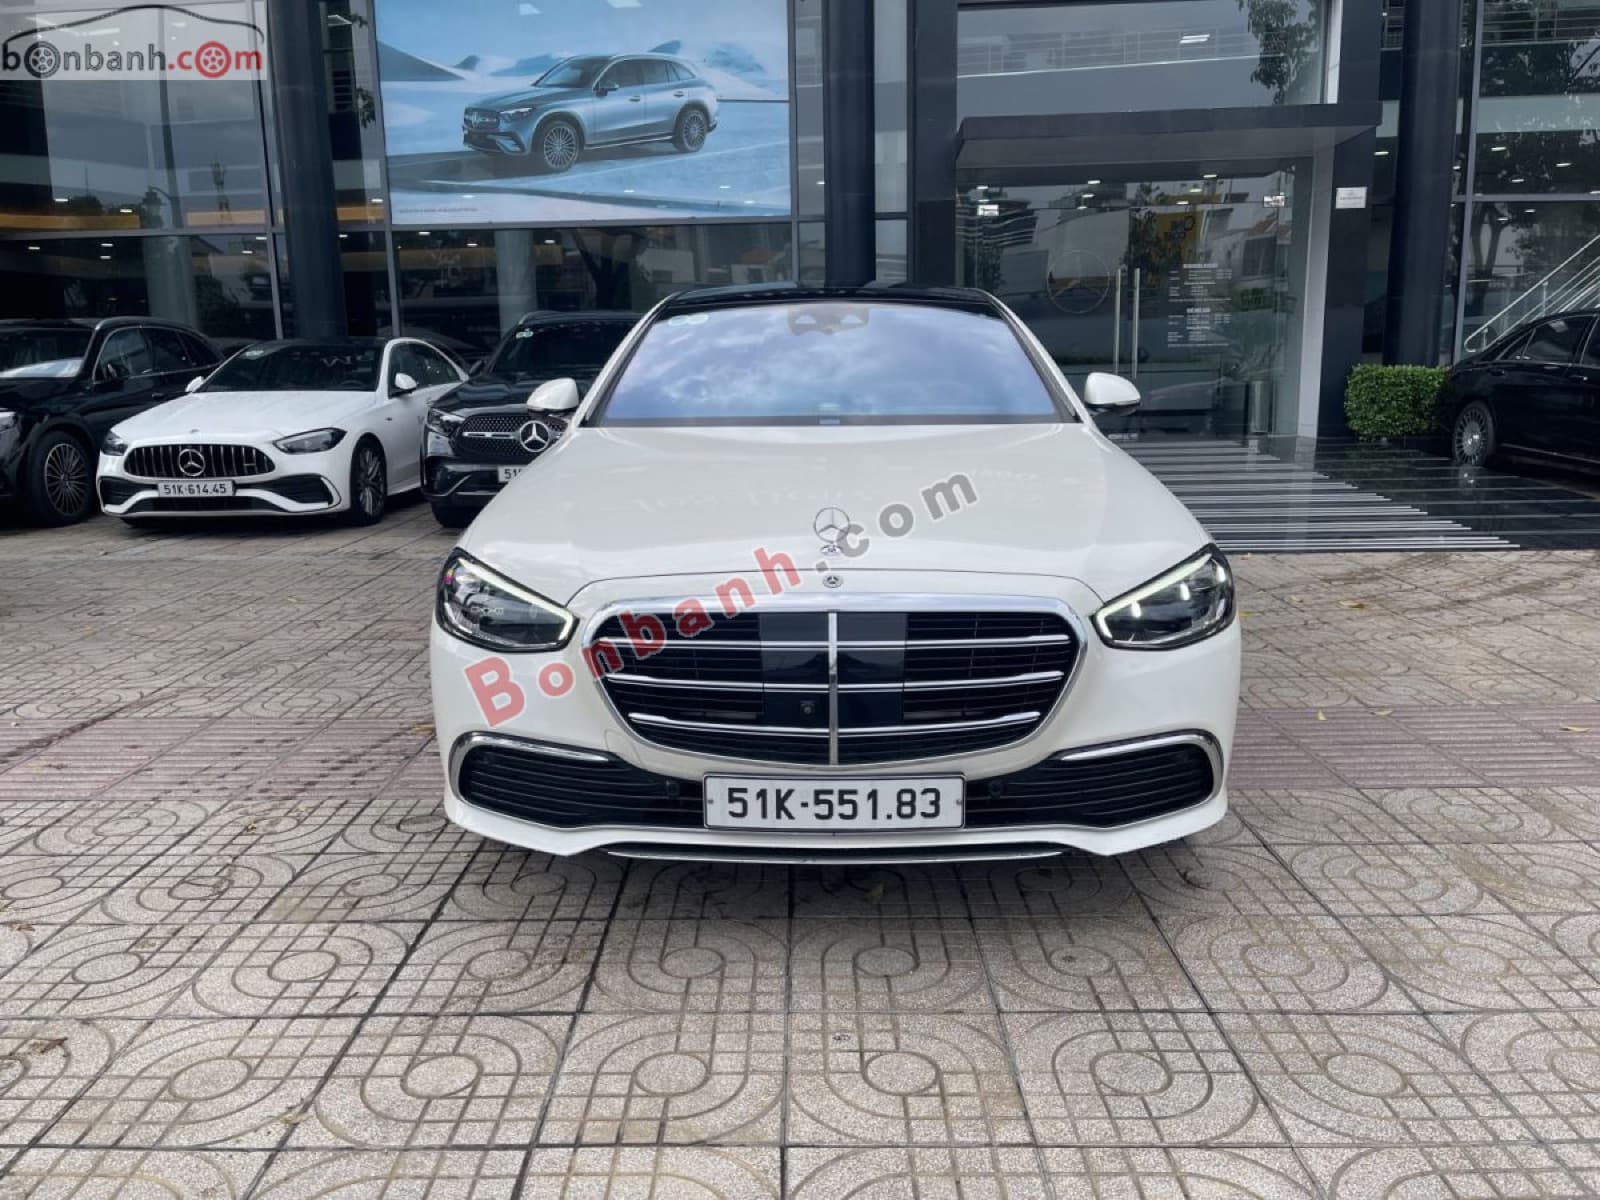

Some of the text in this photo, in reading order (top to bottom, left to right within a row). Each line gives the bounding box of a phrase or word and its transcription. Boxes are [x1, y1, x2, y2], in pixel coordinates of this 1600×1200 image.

[503, 468, 522, 480] 51
[163, 483, 227, 495] 51K-614.45
[727, 786, 942, 821] 51K-551.83
